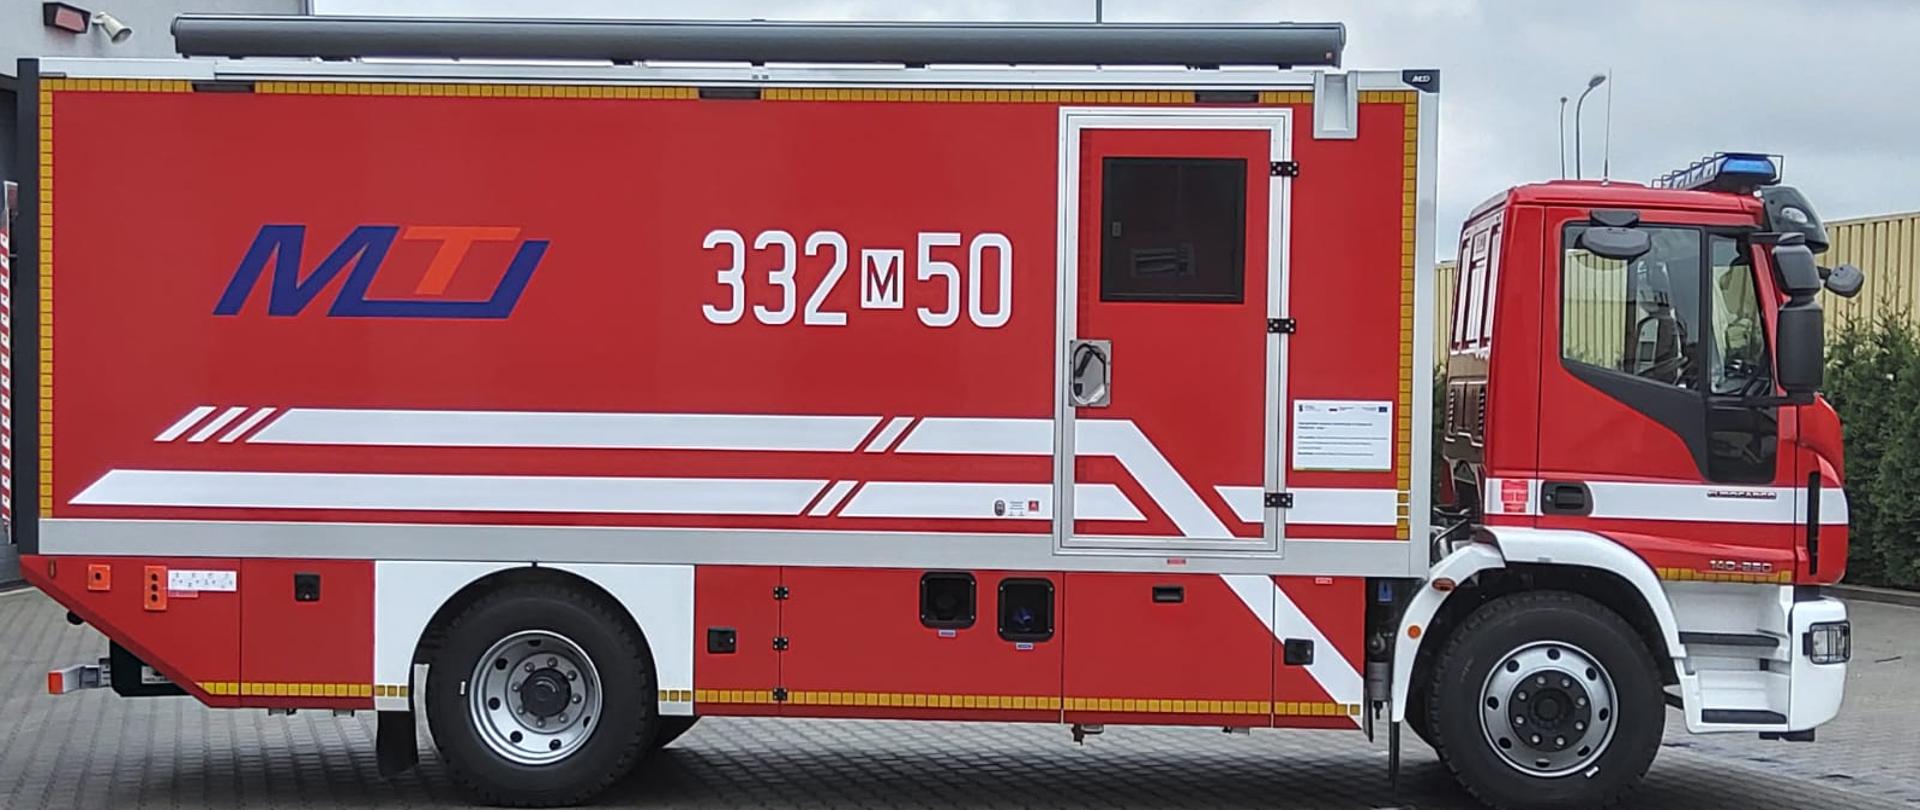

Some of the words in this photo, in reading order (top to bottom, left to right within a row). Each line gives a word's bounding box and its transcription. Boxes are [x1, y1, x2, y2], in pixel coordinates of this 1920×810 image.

[702, 230, 848, 325] 332
[865, 253, 900, 304] M
[917, 232, 1013, 328] 50
